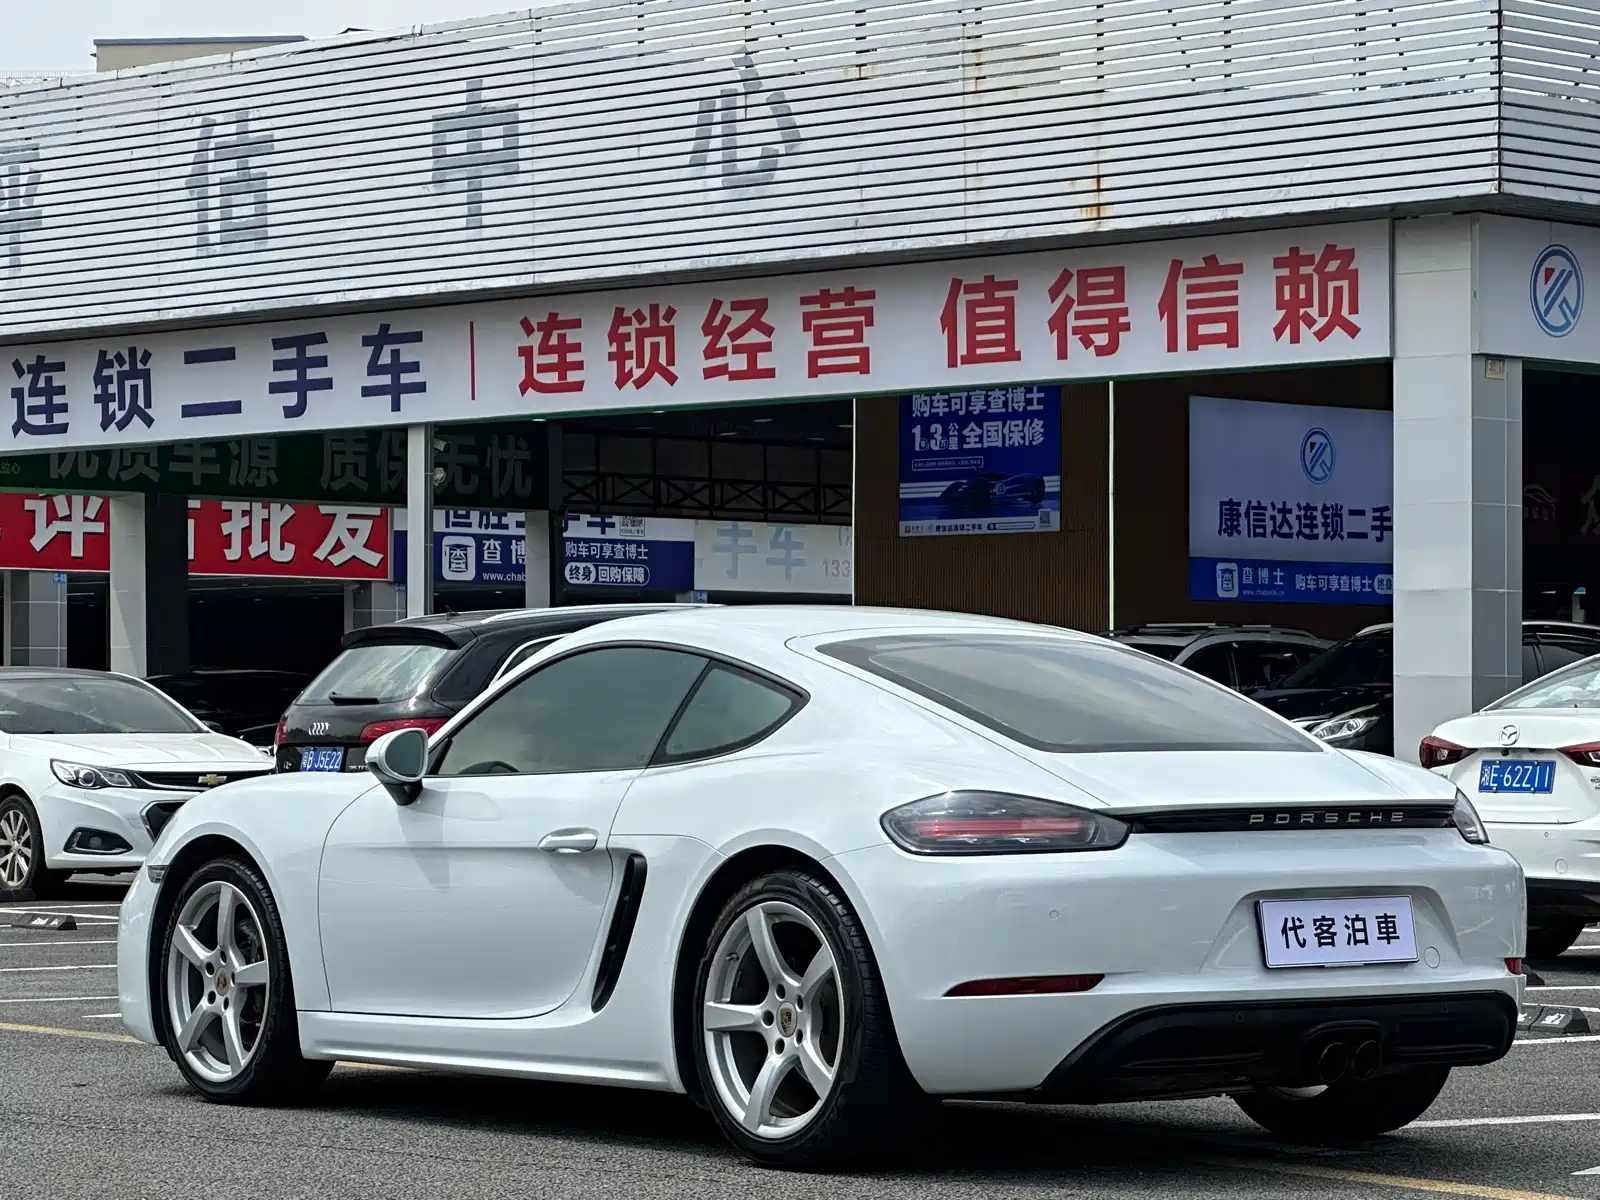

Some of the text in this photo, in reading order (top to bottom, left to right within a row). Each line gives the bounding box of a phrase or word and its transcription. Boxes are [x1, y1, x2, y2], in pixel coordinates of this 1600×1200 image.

[11, 243, 1361, 438] 连锁二手车 连锁经营 值得信赖
[911, 386, 1045, 417] 购车可享查博士
[962, 418, 1045, 449] 全国保修
[24, 493, 385, 568] 评批发
[565, 541, 649, 559] 购车可享查博士
[568, 564, 645, 584] 终身 回购保障
[1242, 566, 1285, 586] 查博士
[1294, 572, 1373, 594] 购车可享查博士
[1249, 811, 1404, 825] PORSCHE
[1281, 913, 1400, 949] 代客泊車
